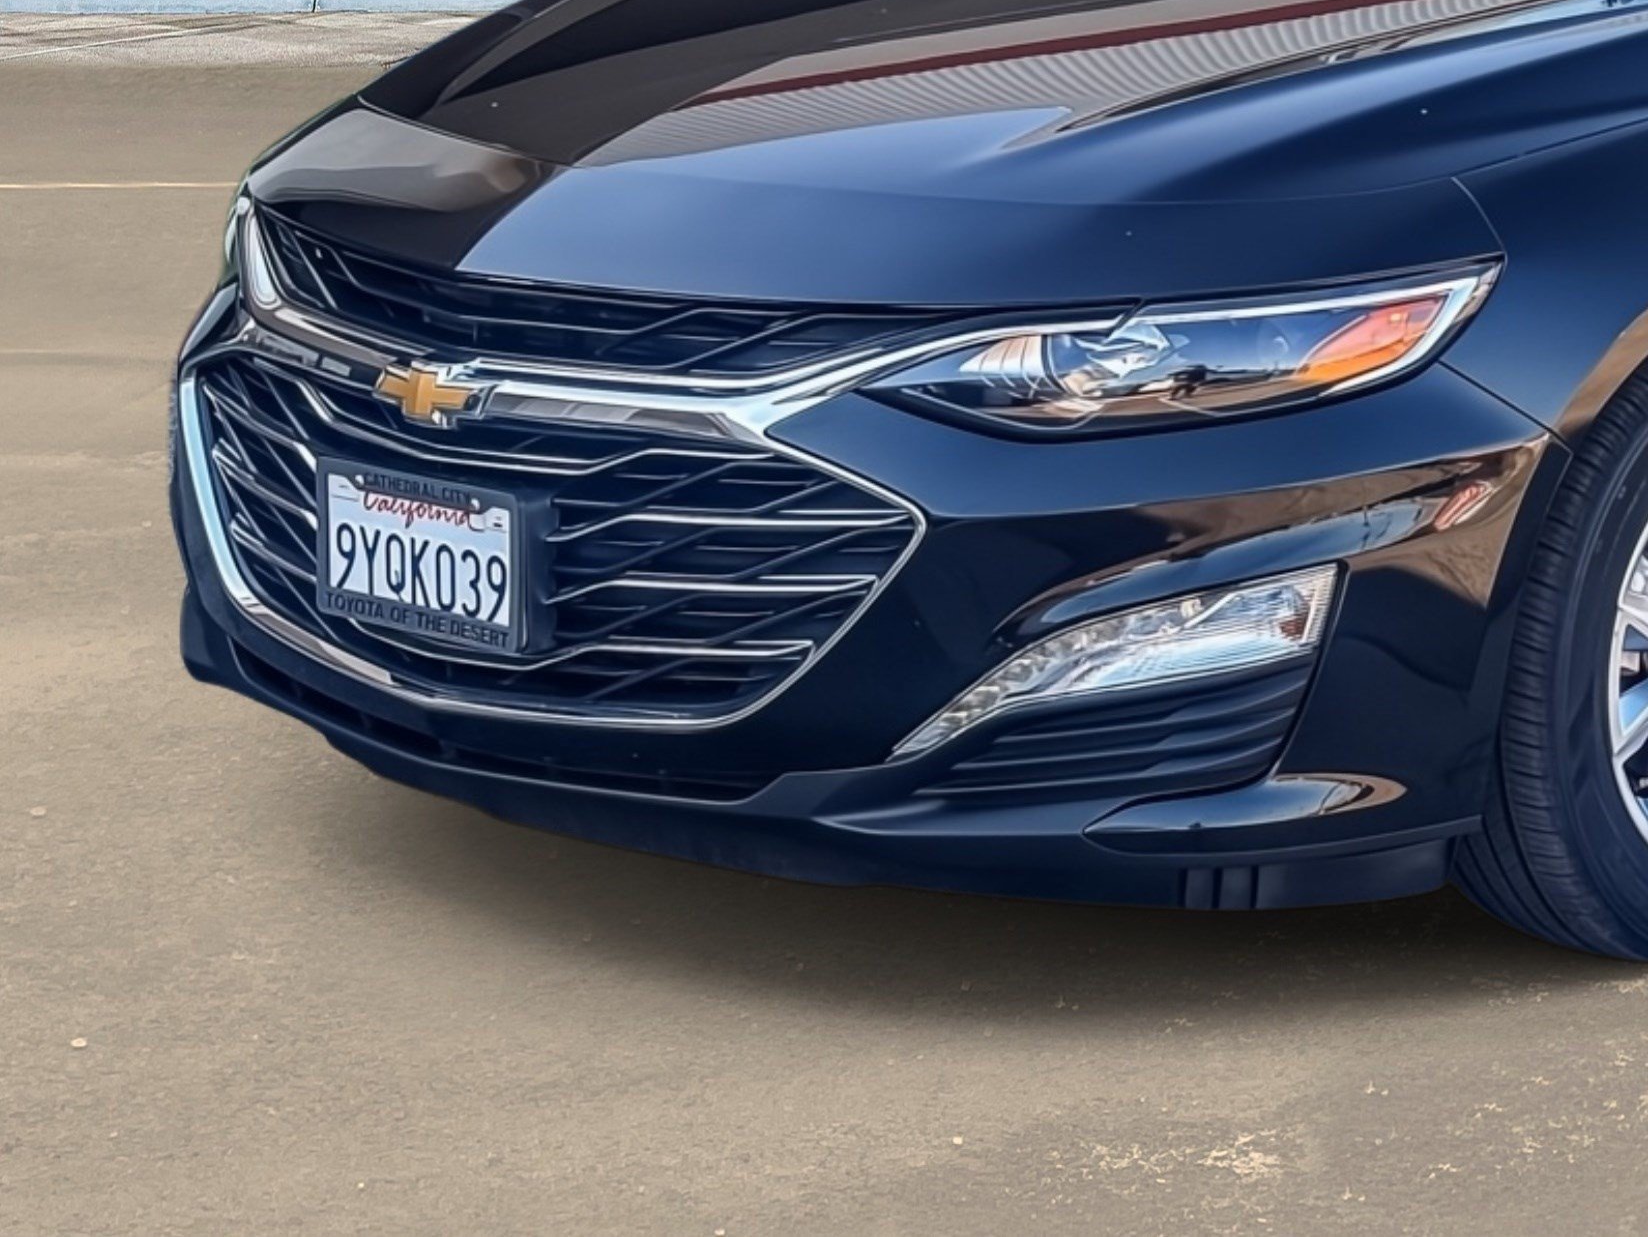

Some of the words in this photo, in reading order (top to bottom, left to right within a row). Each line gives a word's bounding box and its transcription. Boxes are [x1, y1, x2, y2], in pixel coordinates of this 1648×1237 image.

[364, 471, 438, 498] CATHEDRAL
[442, 487, 472, 505] CITY
[335, 522, 508, 623] 9YQK039
[326, 593, 385, 620] TOYOTA
[392, 607, 411, 625] OF
[416, 611, 445, 632] THE
[451, 619, 509, 649] DESERT
